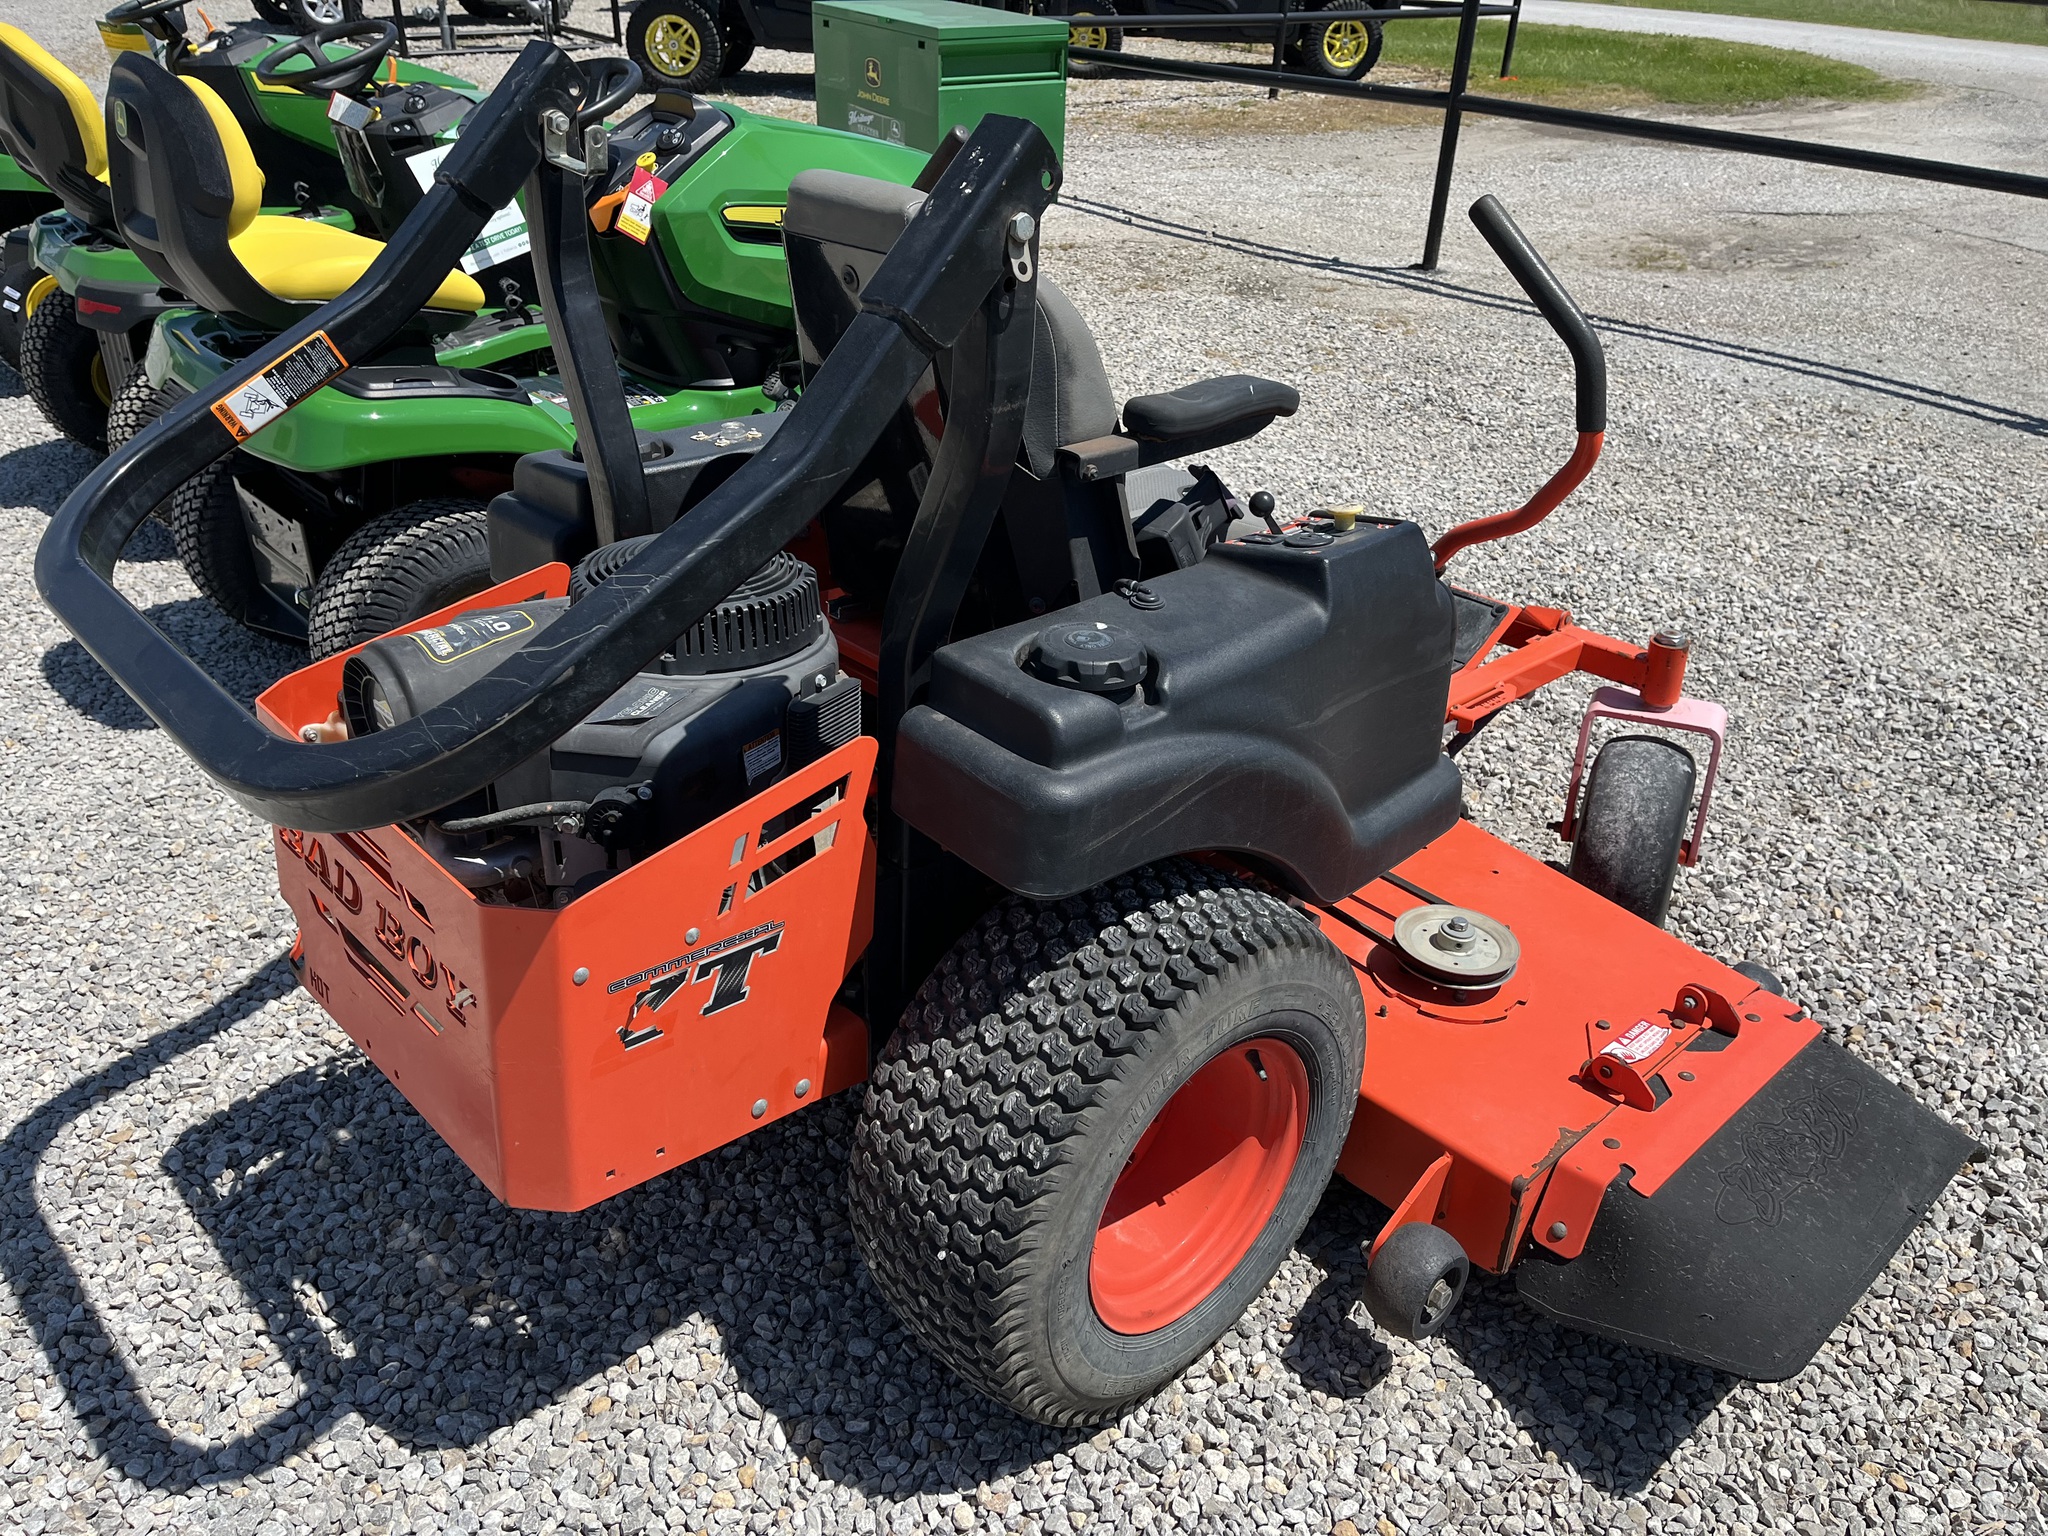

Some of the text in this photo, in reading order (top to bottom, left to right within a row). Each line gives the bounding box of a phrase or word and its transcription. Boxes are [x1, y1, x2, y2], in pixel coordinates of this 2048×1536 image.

[857, 89, 890, 106] JOHN DEERE
[215, 404, 238, 429] WARNING
[631, 690, 669, 716] CLEANER
[279, 828, 477, 1028] BAD BOY
[607, 920, 785, 995] COMMERCIAL
[309, 967, 331, 1004] HOT
[1624, 1020, 1651, 1040] DANGER
[1117, 996, 1261, 1144] SUPER TURF
